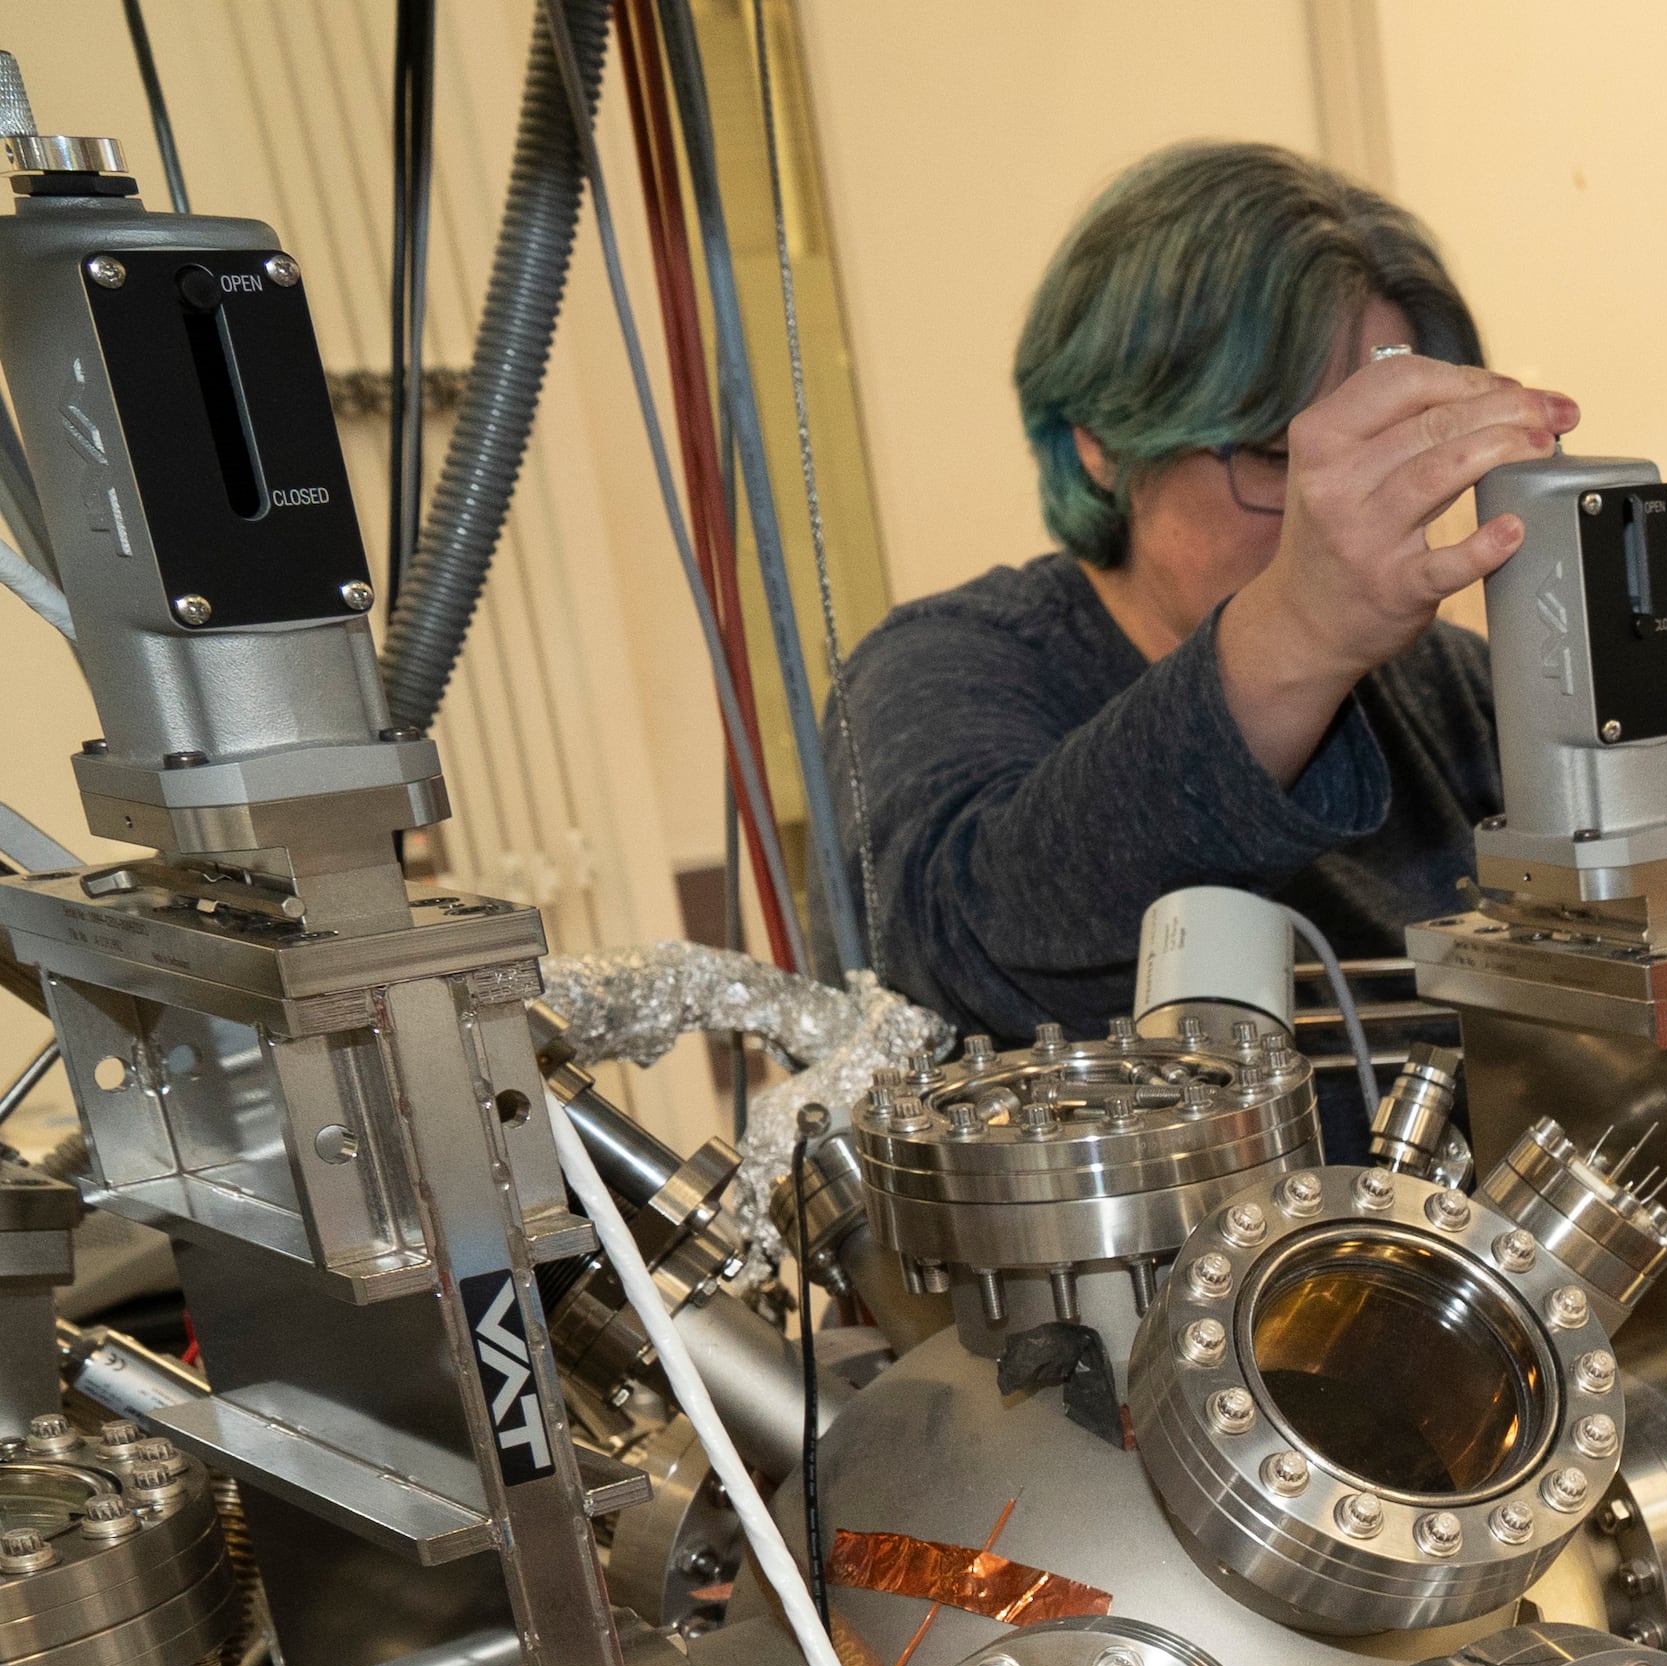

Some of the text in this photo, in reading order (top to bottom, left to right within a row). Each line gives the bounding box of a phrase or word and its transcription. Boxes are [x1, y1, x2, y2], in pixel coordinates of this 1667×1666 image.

[220, 274, 263, 292] OPEN
[272, 487, 330, 507] CLOSED
[1644, 500, 1666, 514] OPEN
[475, 1276, 552, 1470] VAT
